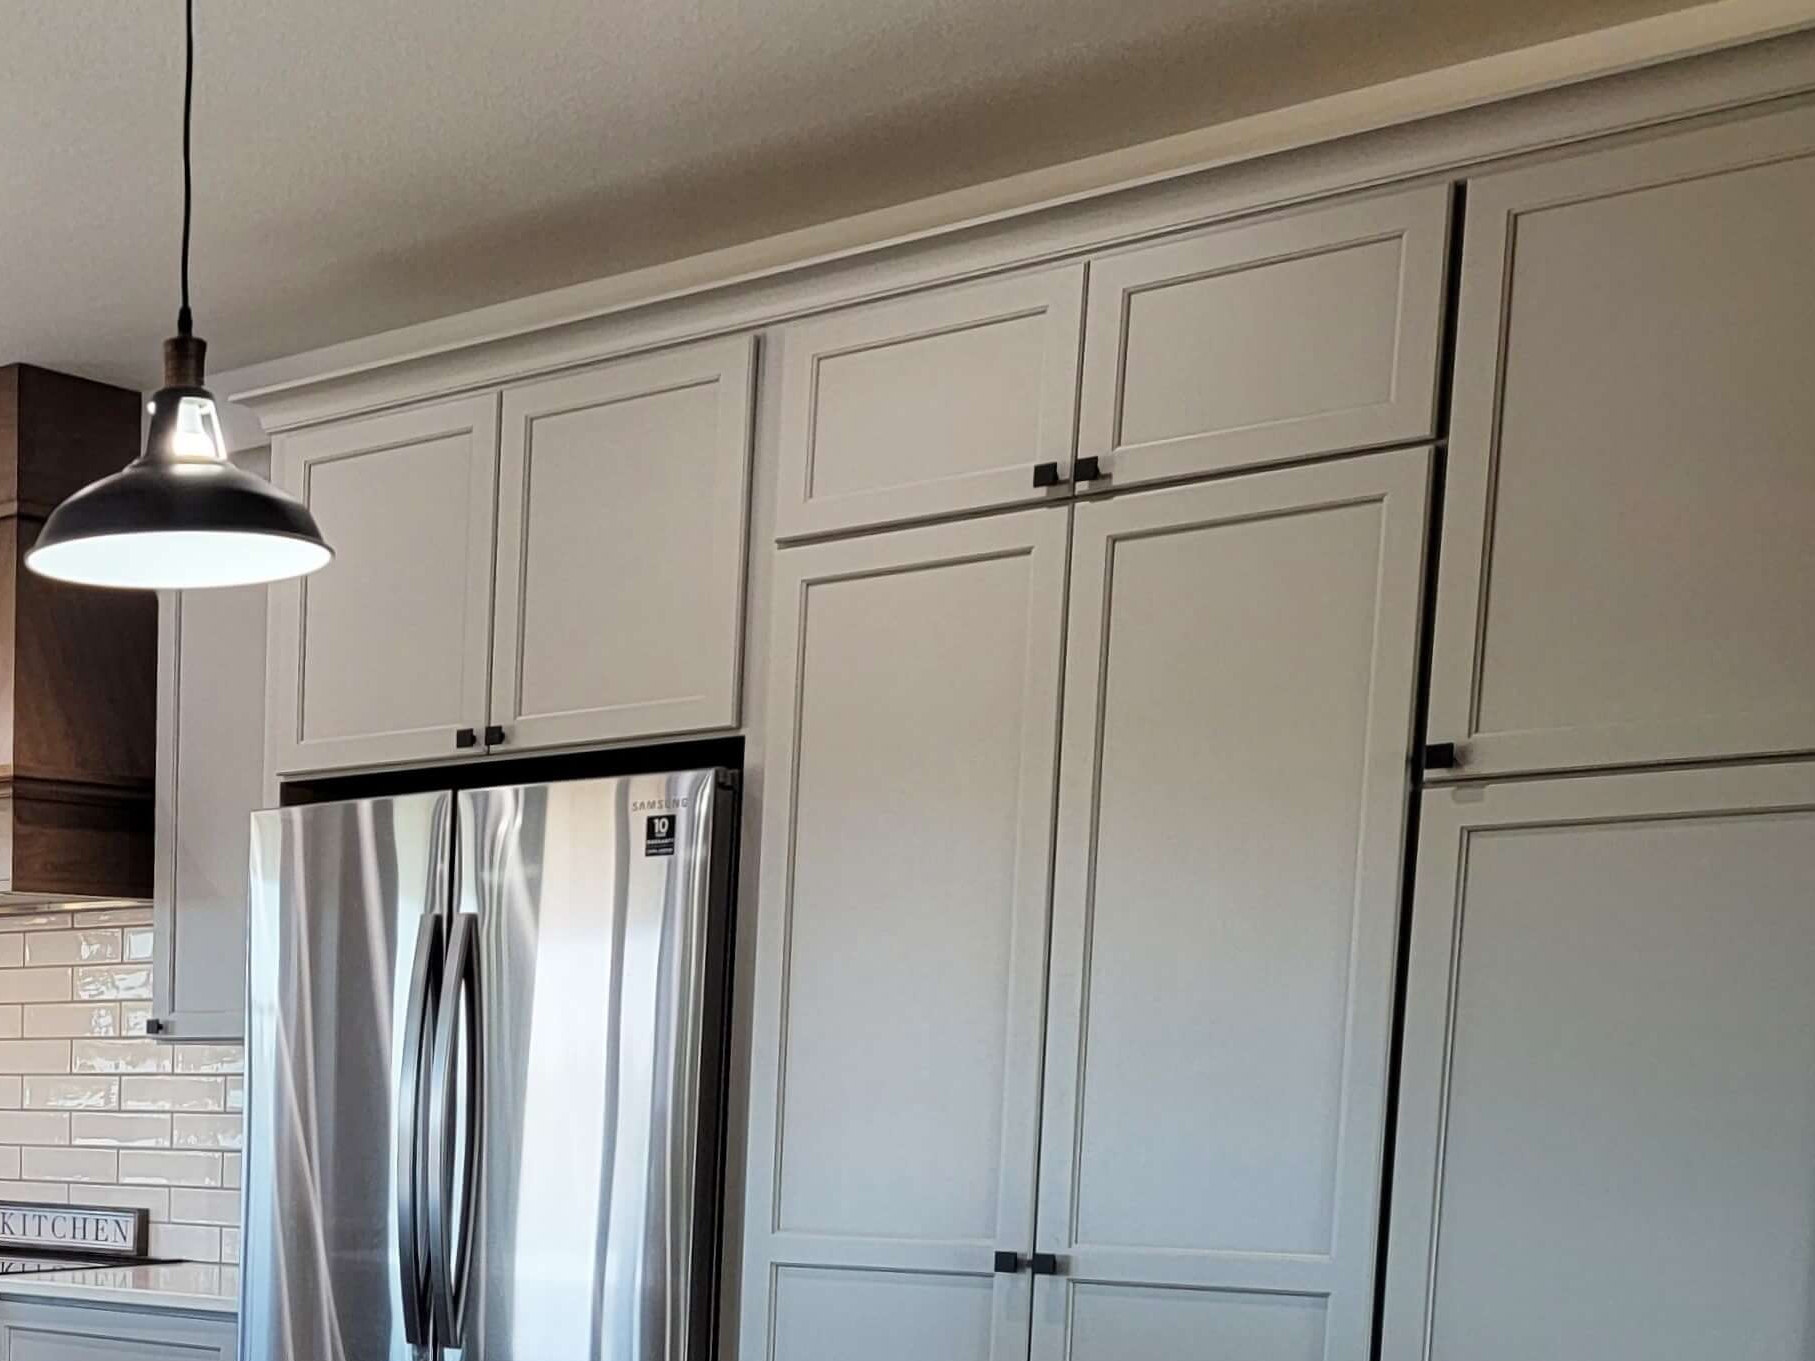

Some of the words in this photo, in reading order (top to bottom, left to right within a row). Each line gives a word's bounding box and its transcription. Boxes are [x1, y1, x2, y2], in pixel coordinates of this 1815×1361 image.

[632, 798, 688, 811] SAMSUNG
[654, 818, 669, 832] 10
[0, 1212, 129, 1243] KITCHEN
